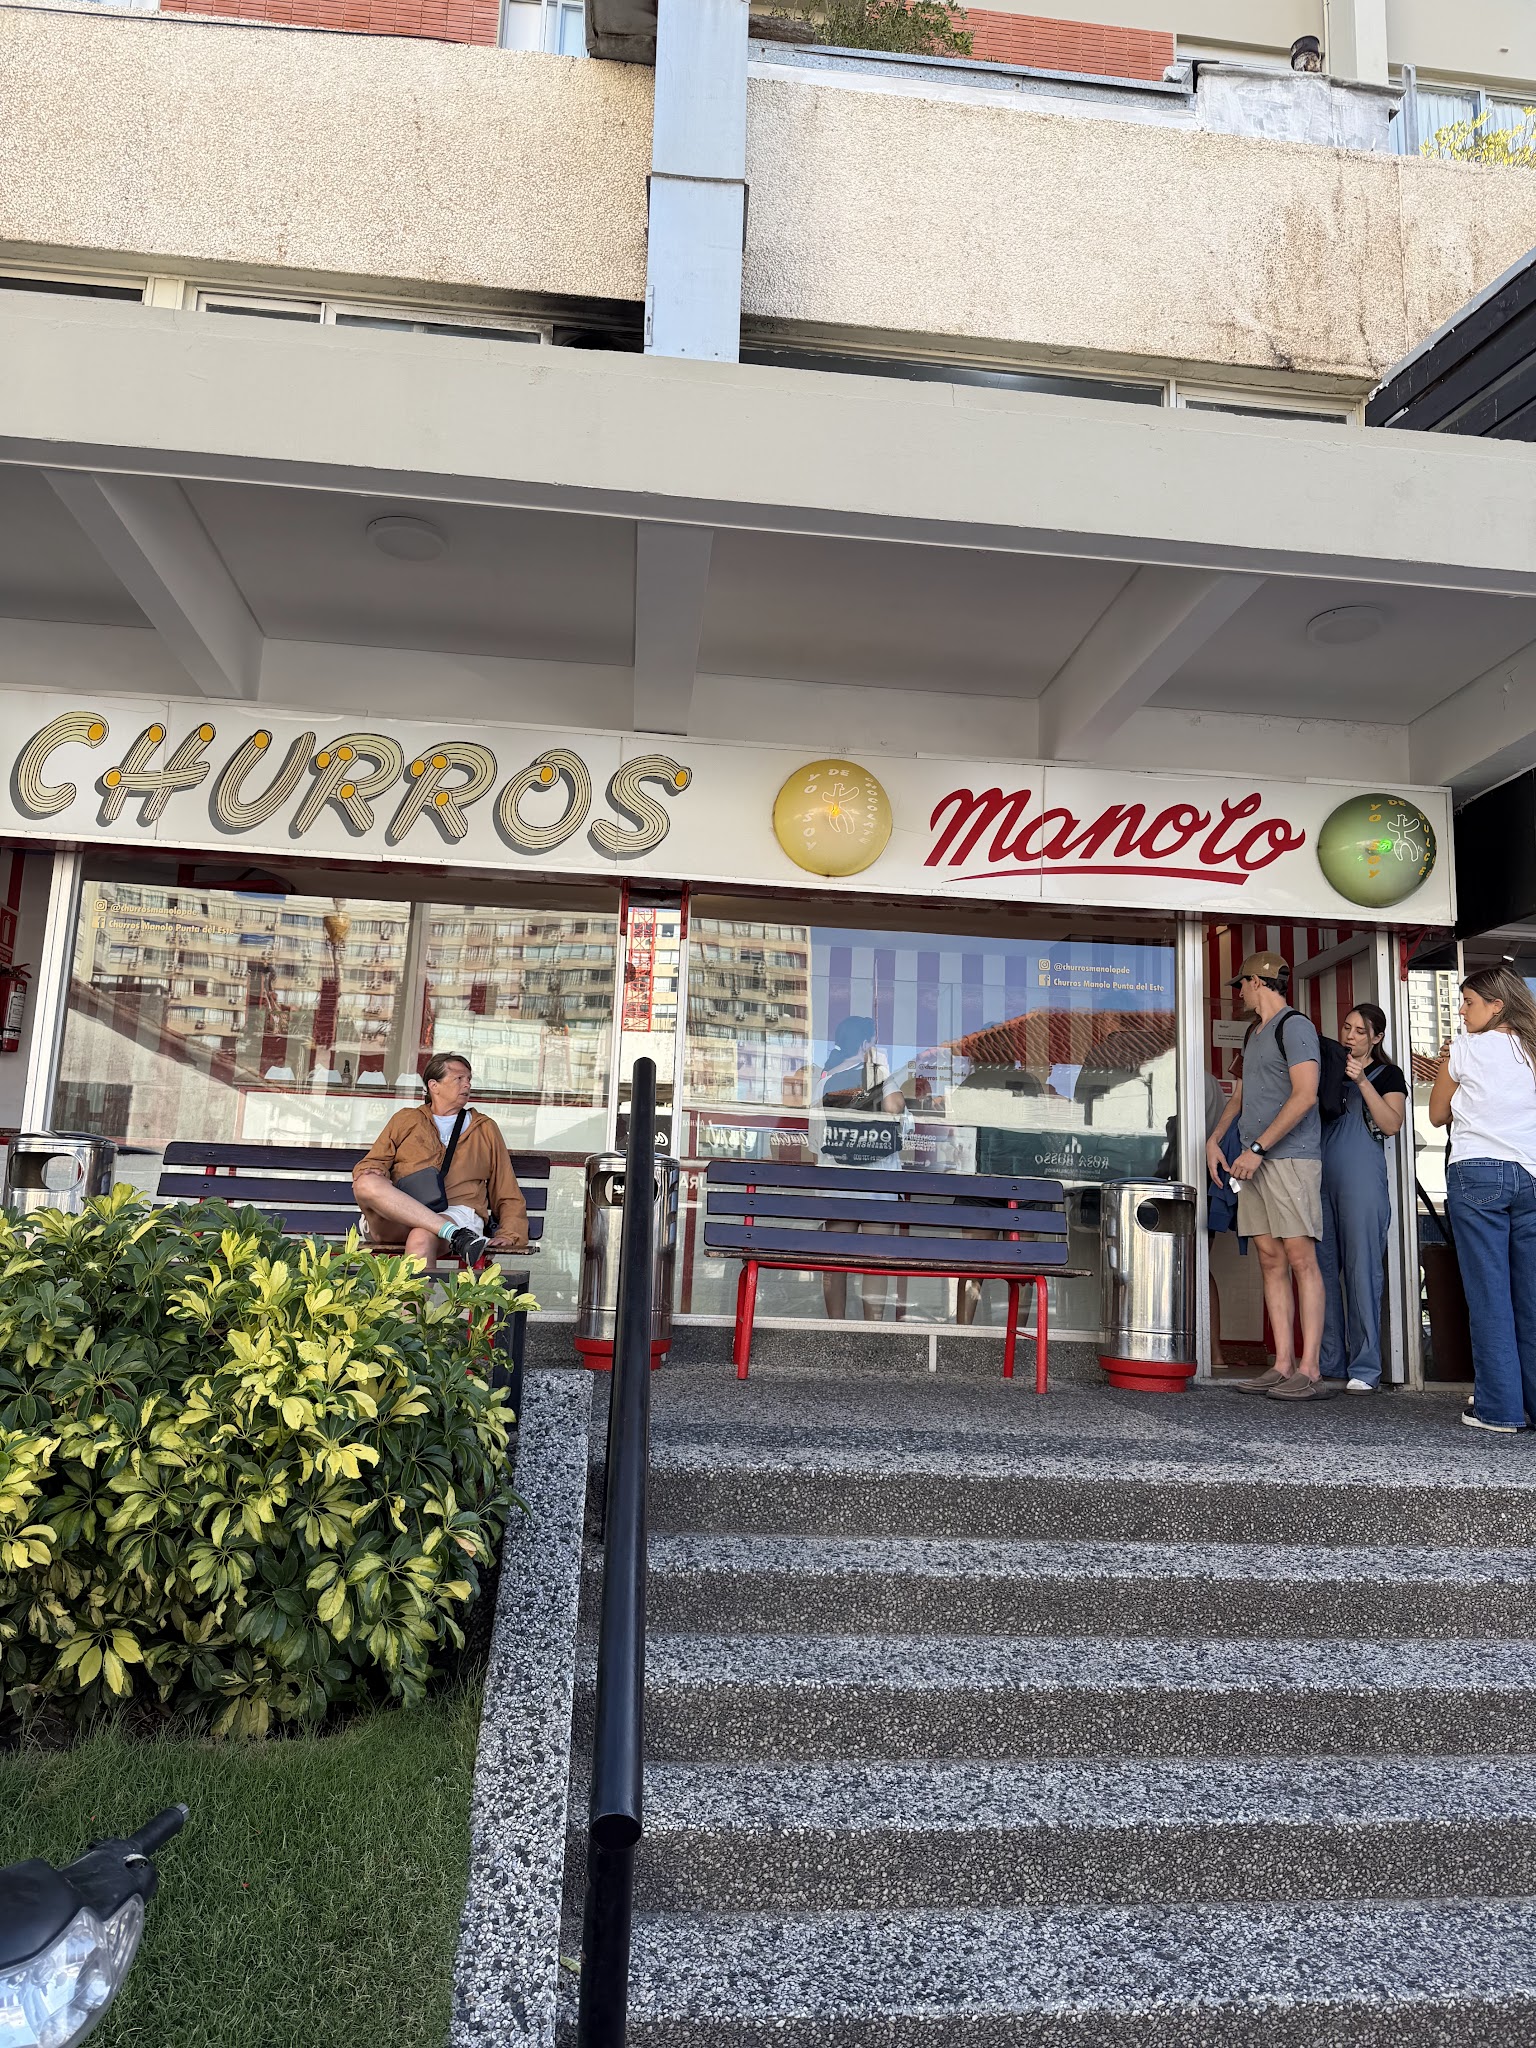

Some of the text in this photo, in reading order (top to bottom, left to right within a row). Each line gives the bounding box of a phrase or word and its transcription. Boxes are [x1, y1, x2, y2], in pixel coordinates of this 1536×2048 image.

[828, 768, 850, 777] DE
[14, 710, 692, 858] CHURROS
[923, 787, 1306, 871] Manolo
[108, 920, 235, 935] Churros Manolo Punta del Este
[1053, 962, 1130, 974] @churrosmanolopde
[1053, 978, 1164, 992] Churros Manolo Punta del Este
